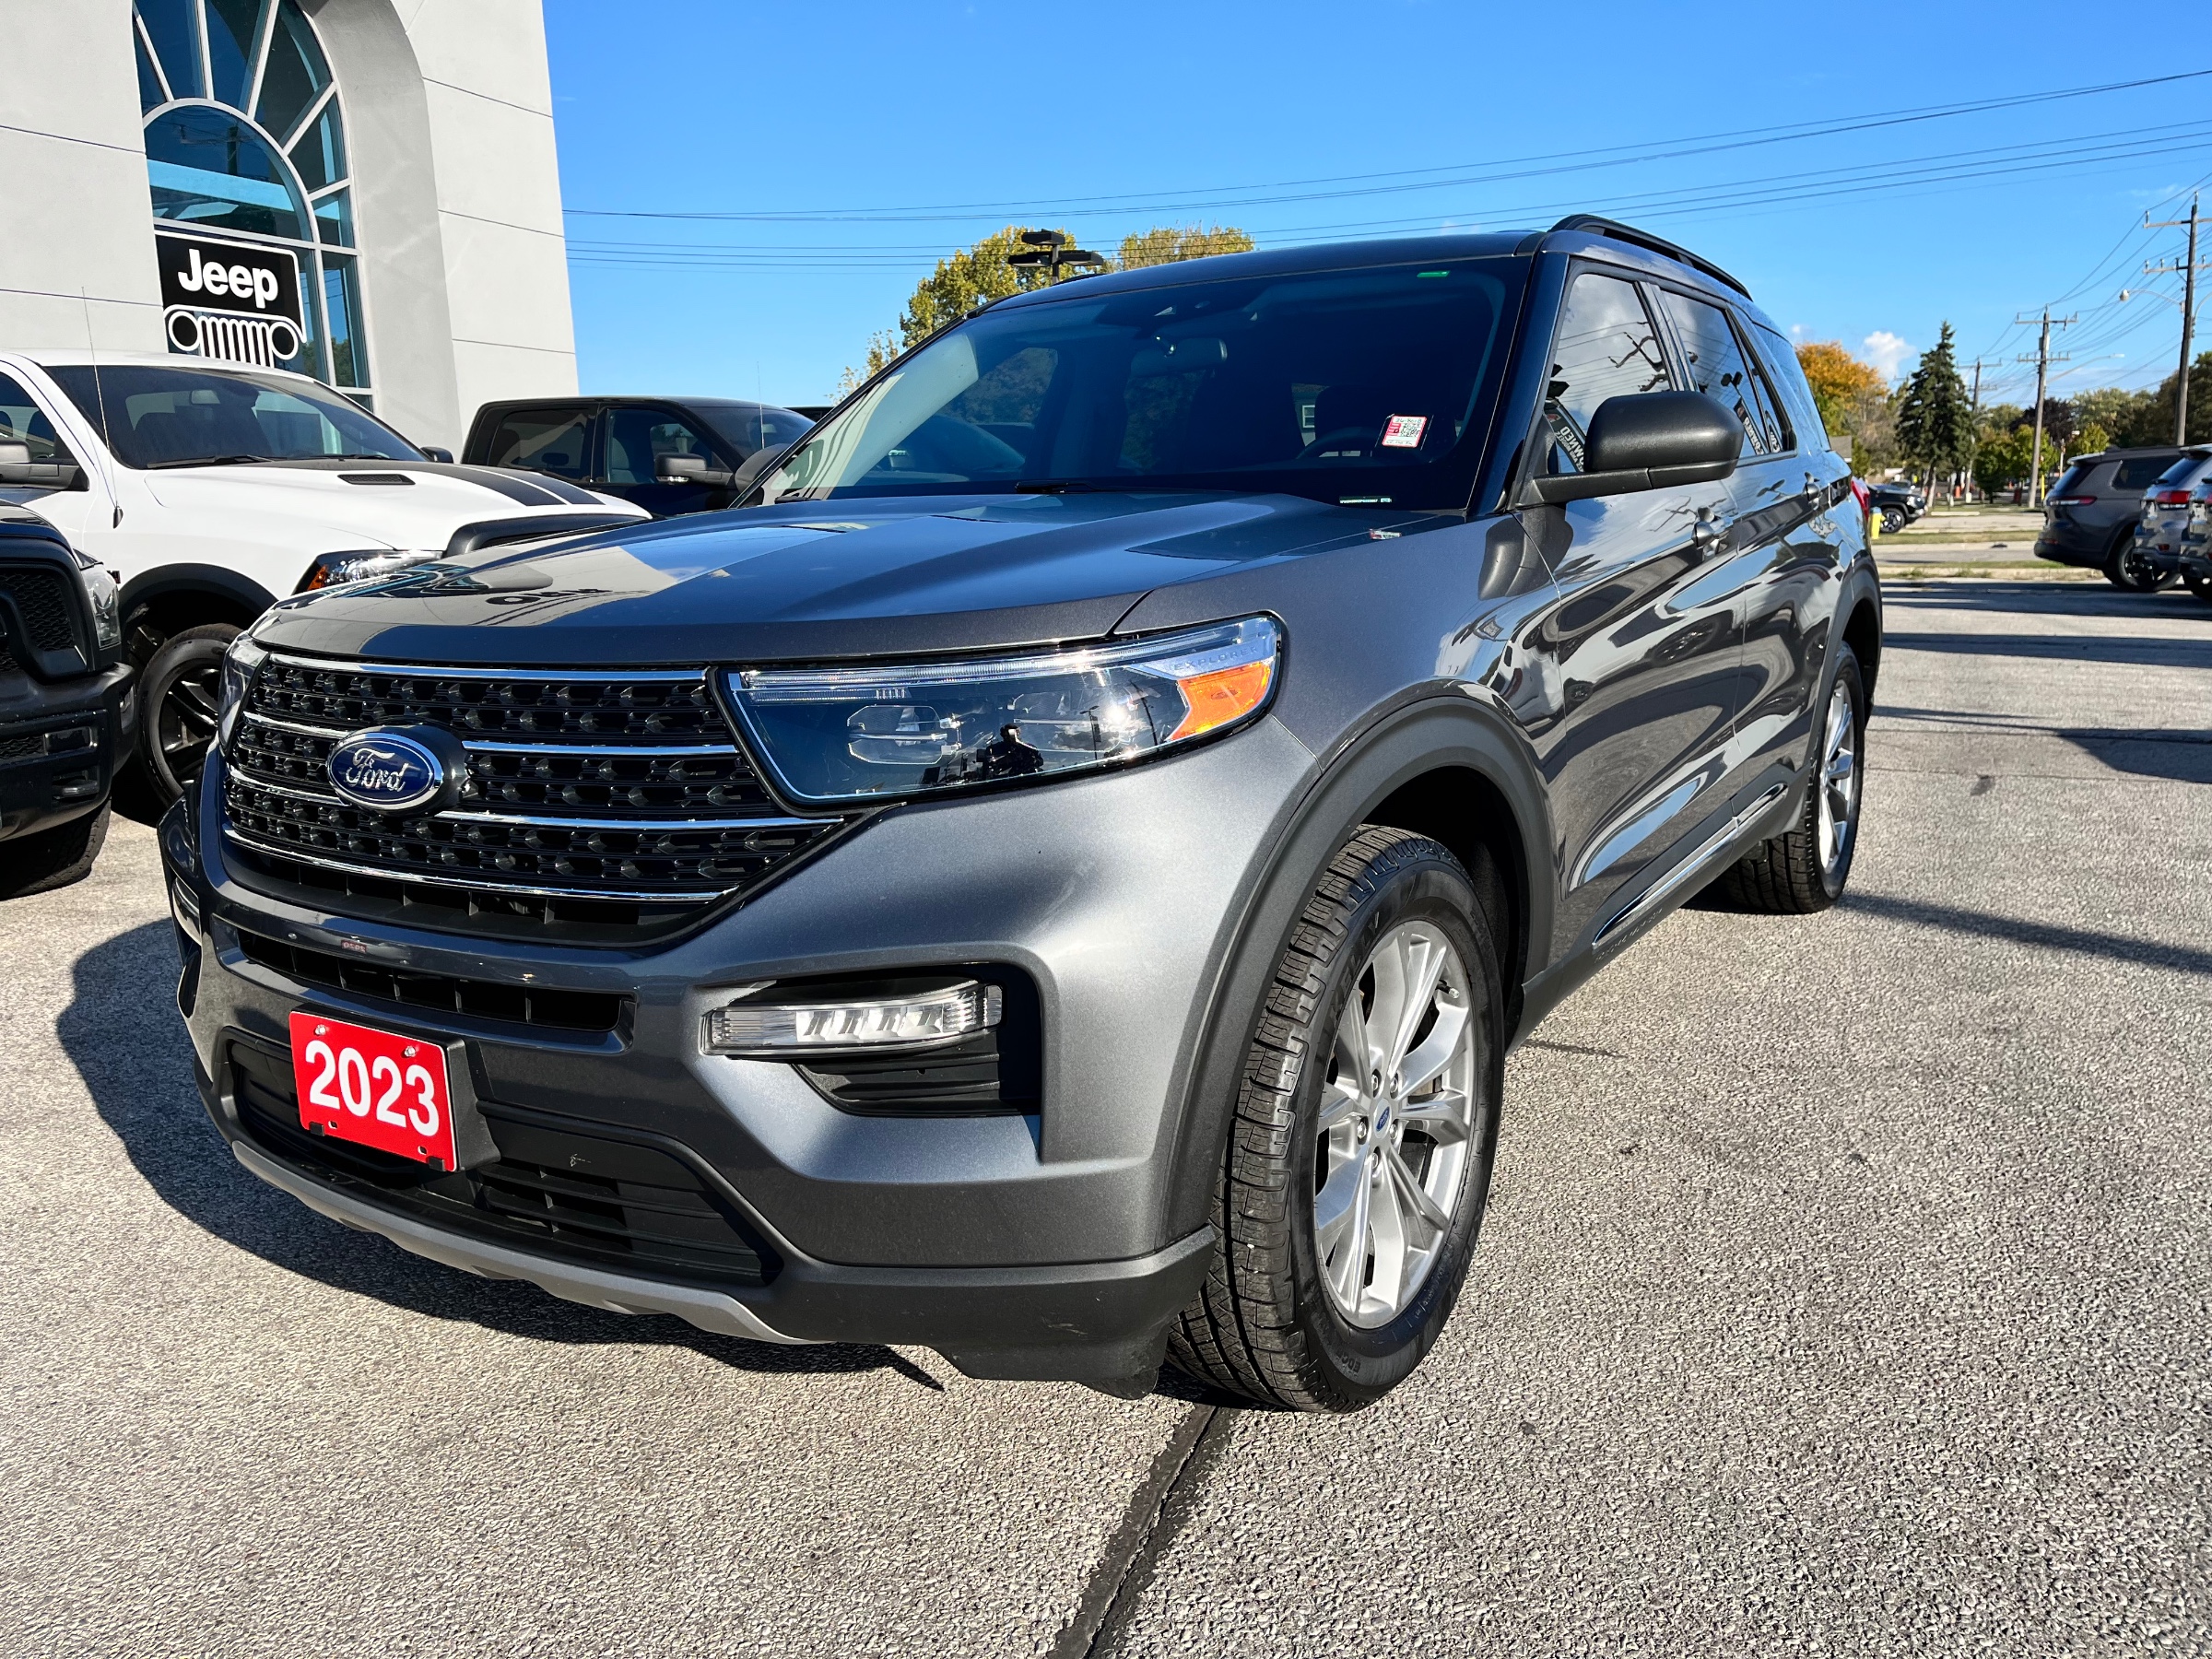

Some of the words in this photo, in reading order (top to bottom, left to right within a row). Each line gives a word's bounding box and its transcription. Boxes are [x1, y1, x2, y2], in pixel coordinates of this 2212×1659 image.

[177, 248, 279, 309] Jeep
[1173, 647, 1258, 670] EXPLORER
[345, 747, 411, 793] Ford
[305, 1040, 440, 1136] 2023
